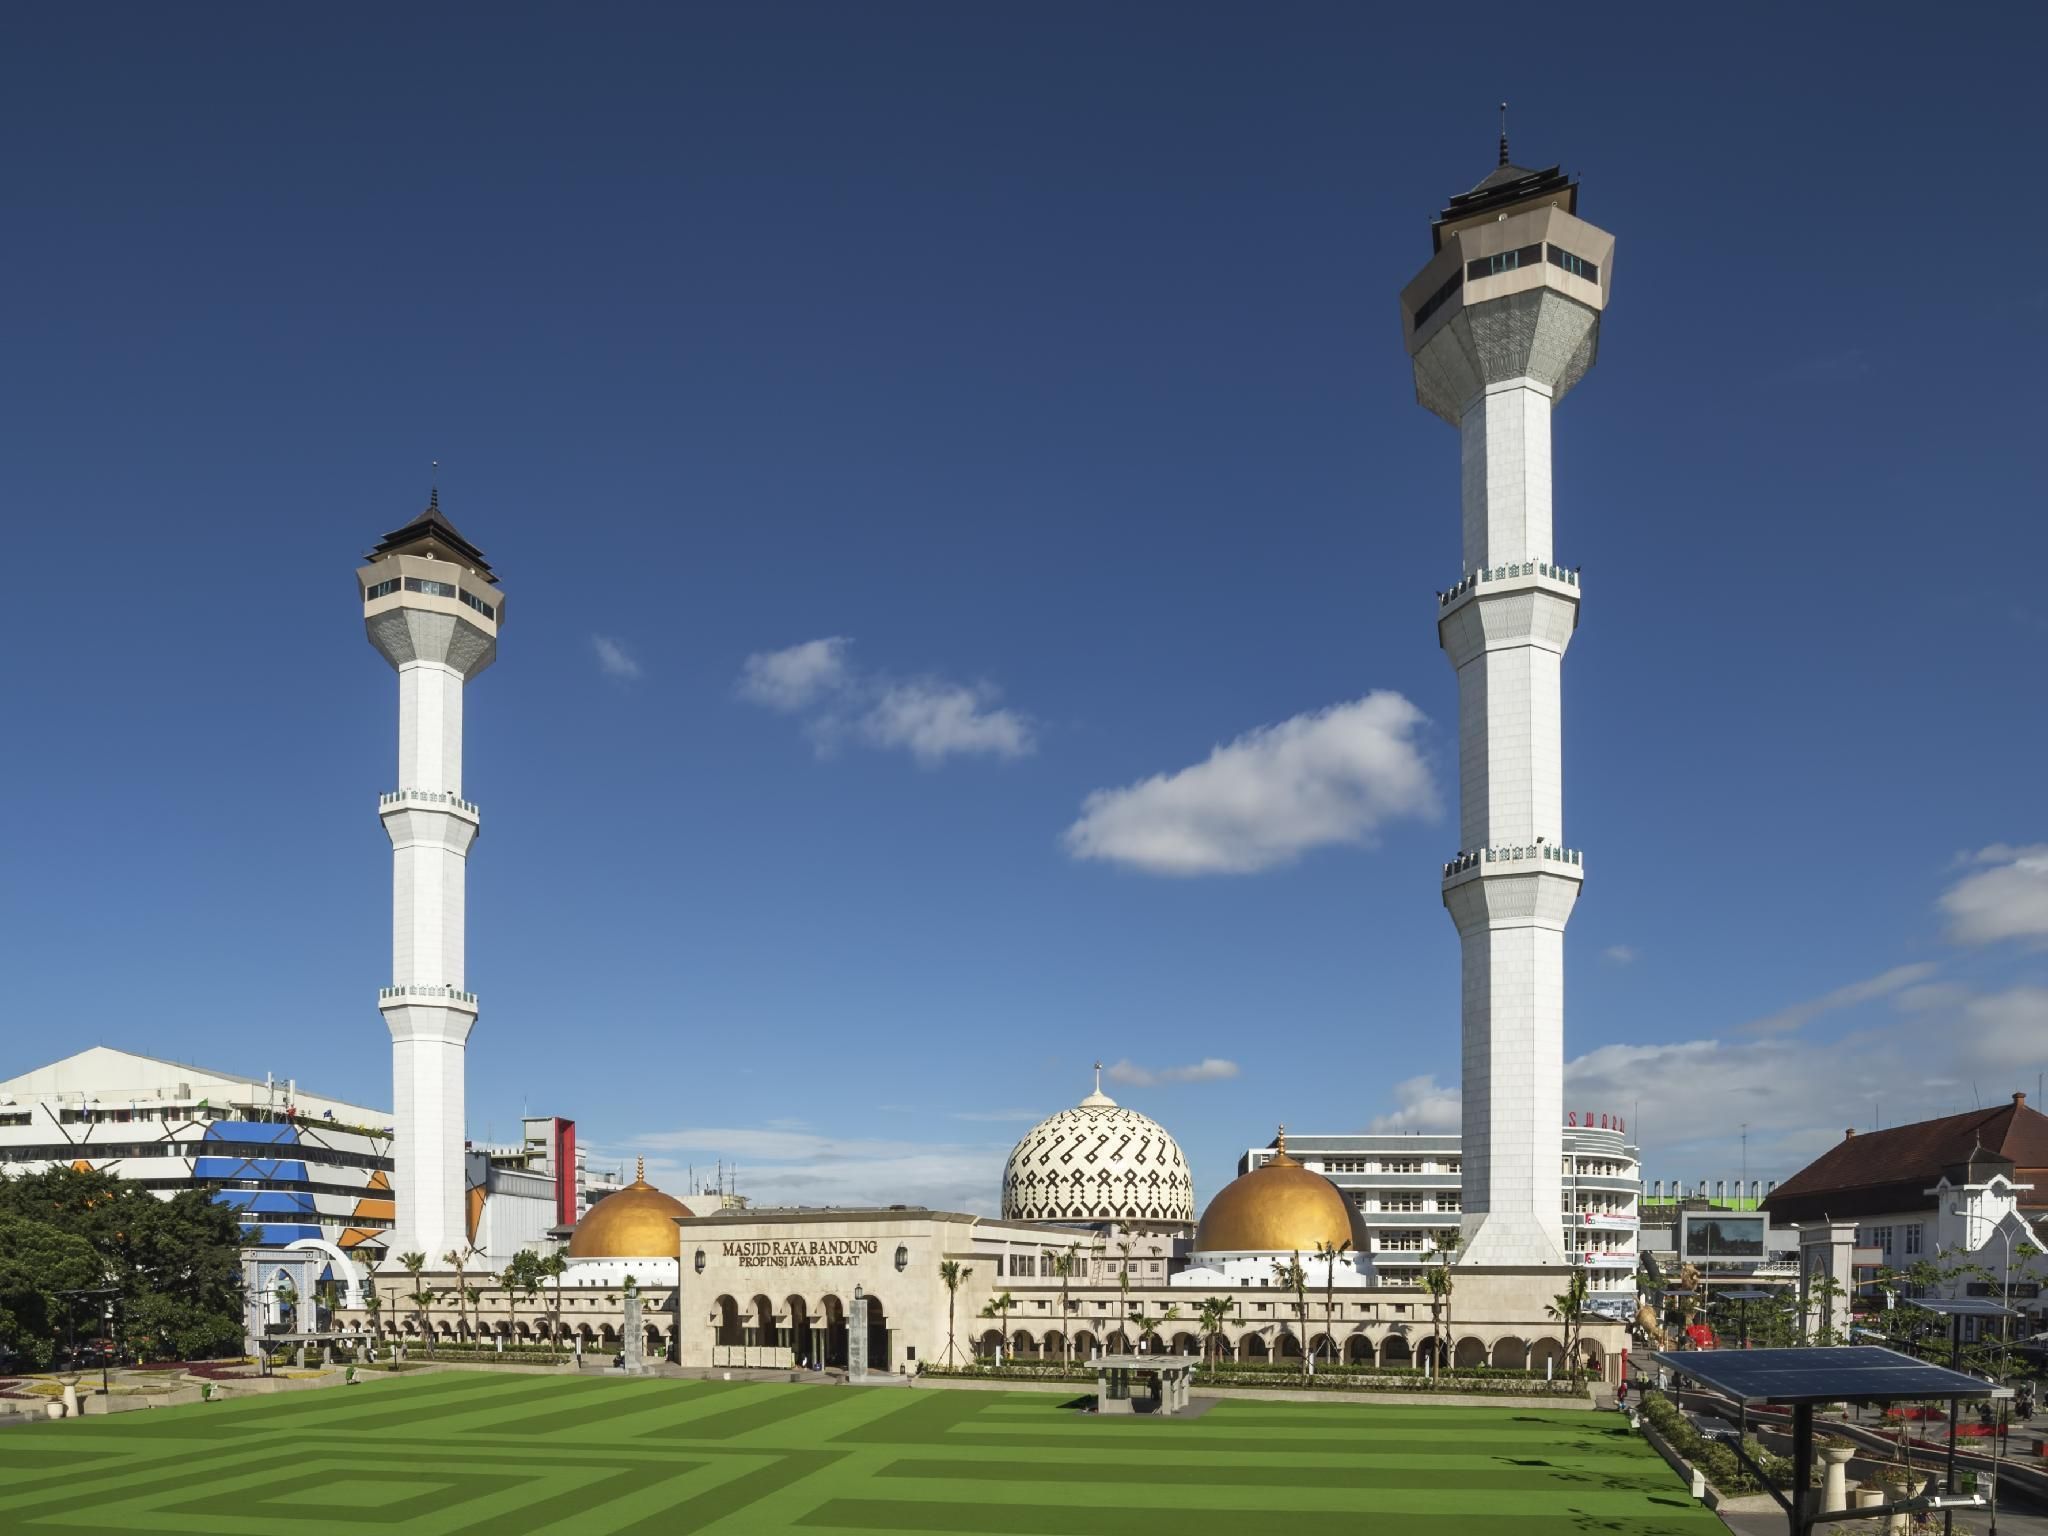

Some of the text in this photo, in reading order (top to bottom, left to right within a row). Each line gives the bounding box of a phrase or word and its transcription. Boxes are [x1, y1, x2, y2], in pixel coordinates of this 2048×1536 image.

[722, 1240, 878, 1256] MASJID RAYA BANDUNG
[739, 1255, 860, 1267] PROPINSI JAWA BARAT
